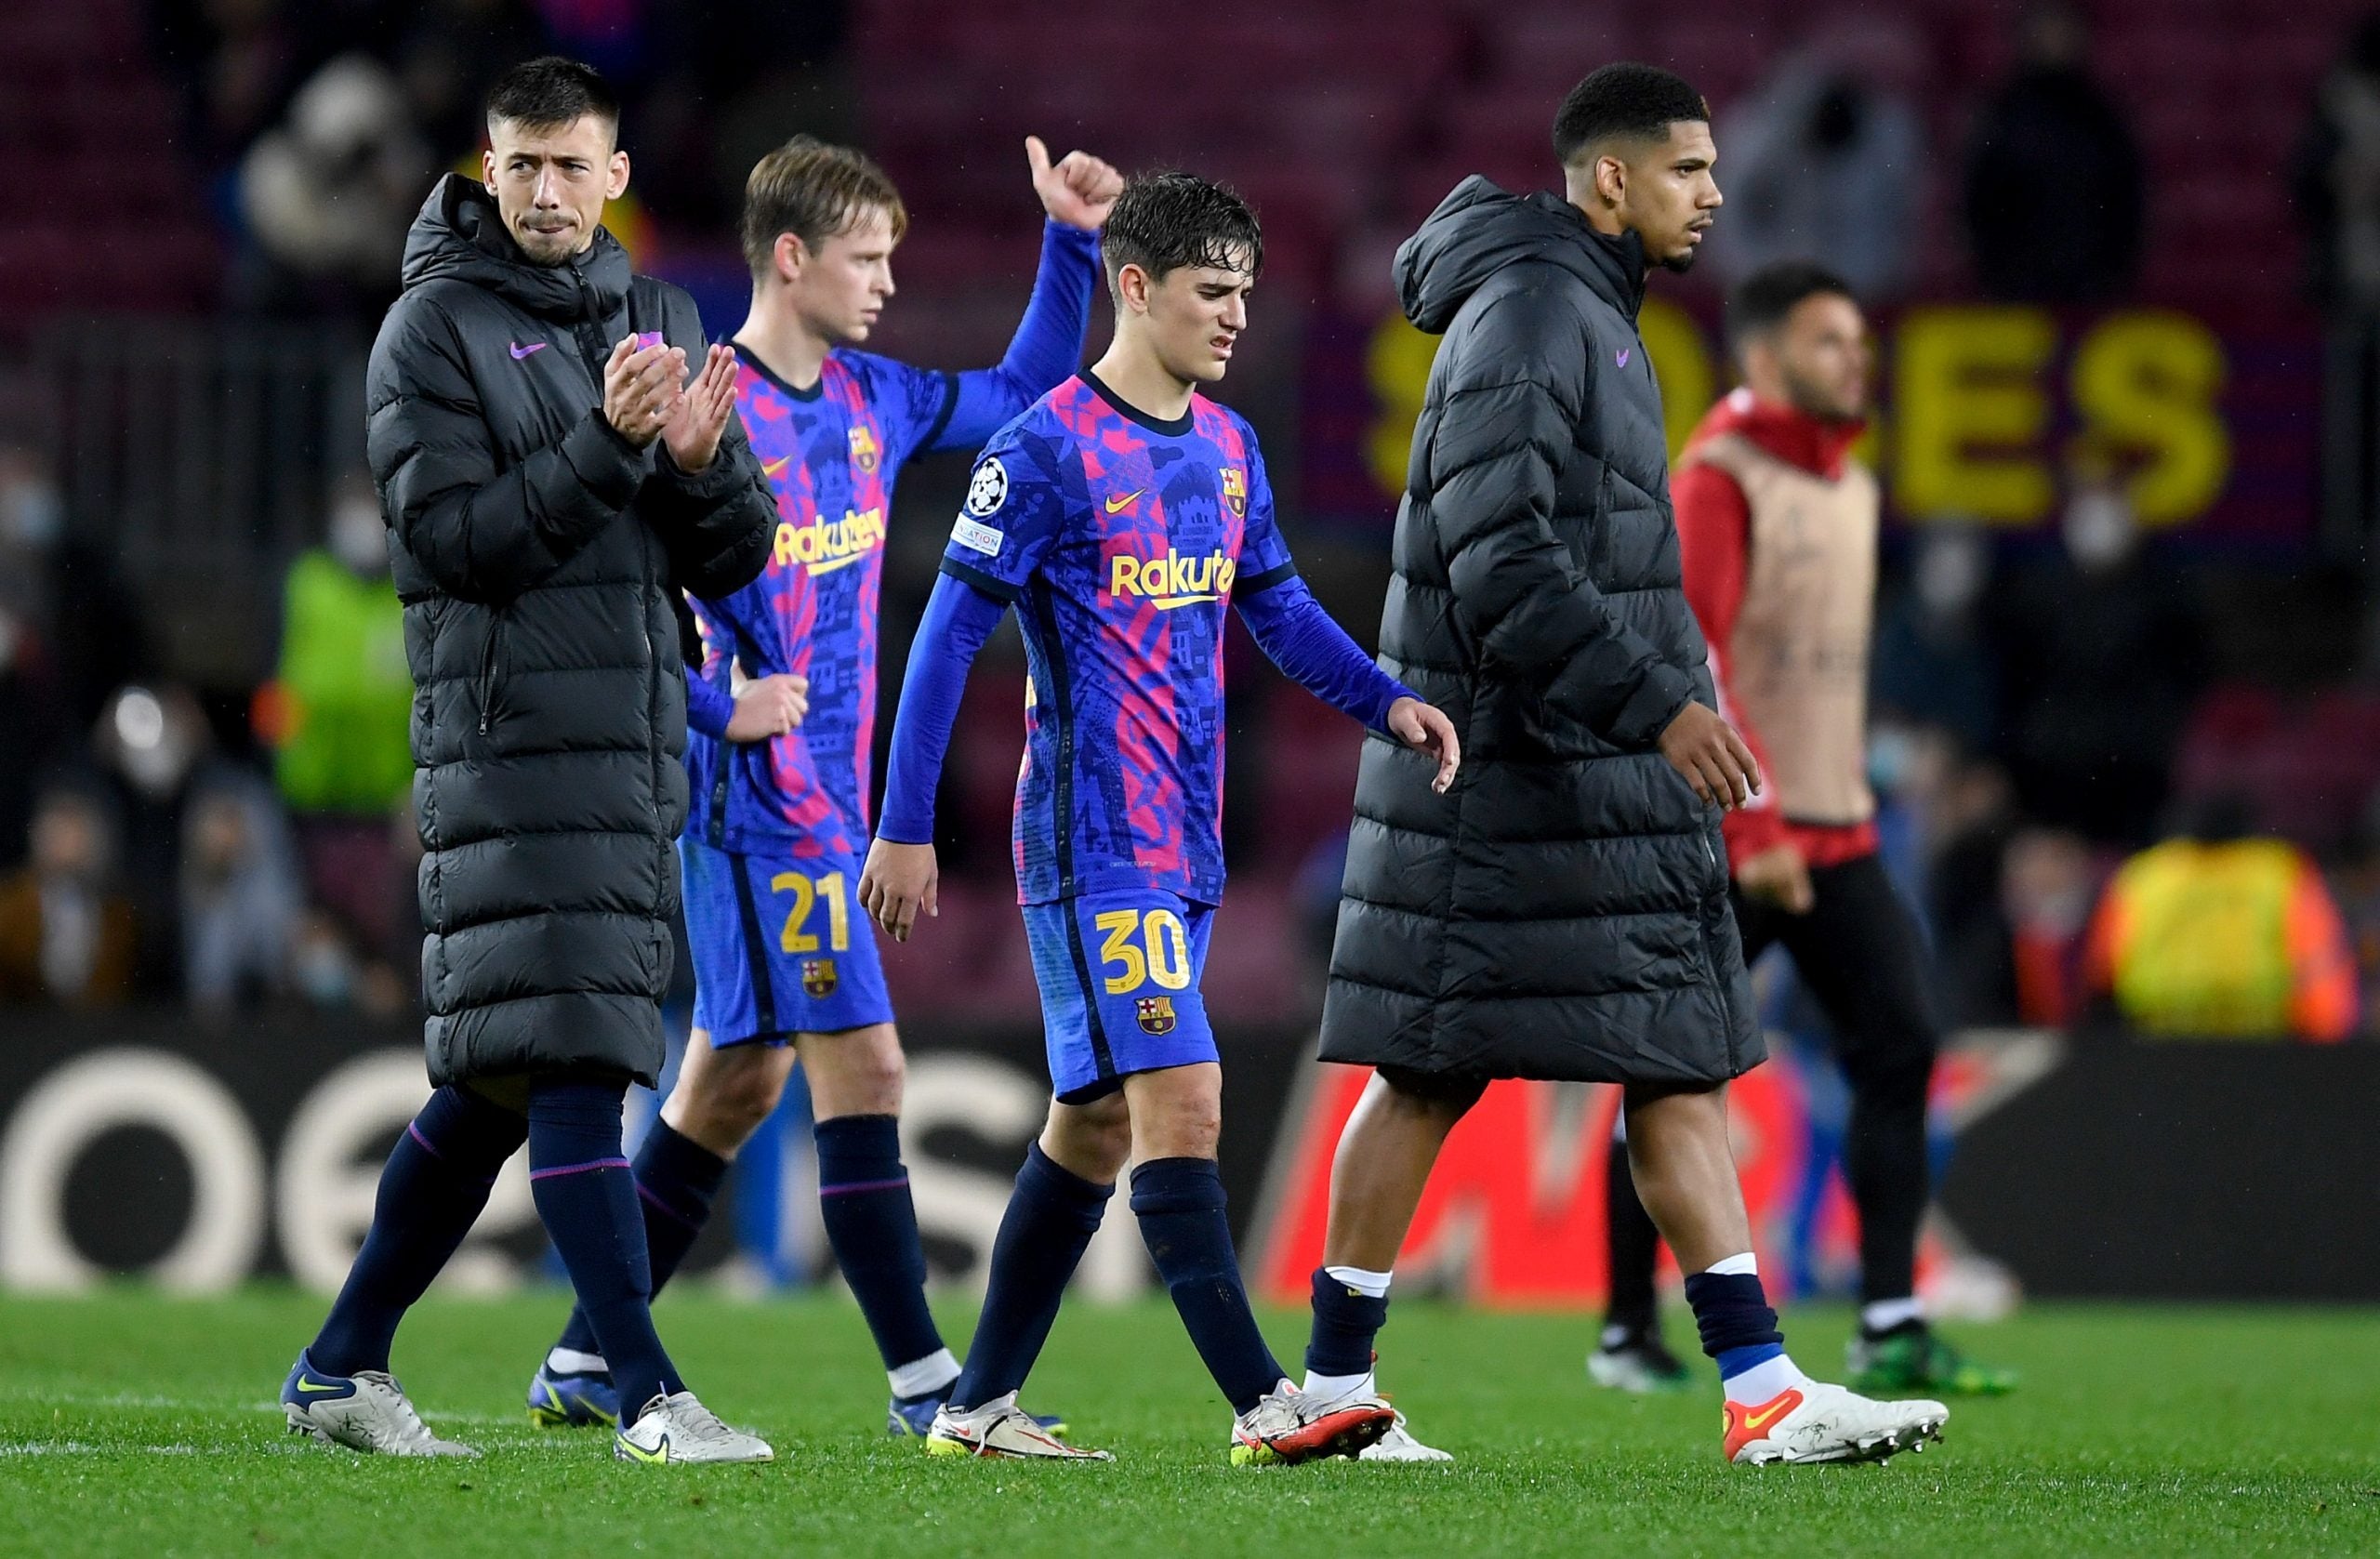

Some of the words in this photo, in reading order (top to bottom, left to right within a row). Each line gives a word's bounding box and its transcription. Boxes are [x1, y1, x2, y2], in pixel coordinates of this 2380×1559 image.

[1111, 548, 1236, 597] Rakute
[771, 872, 850, 953] 21
[1095, 909, 1190, 994] 30
